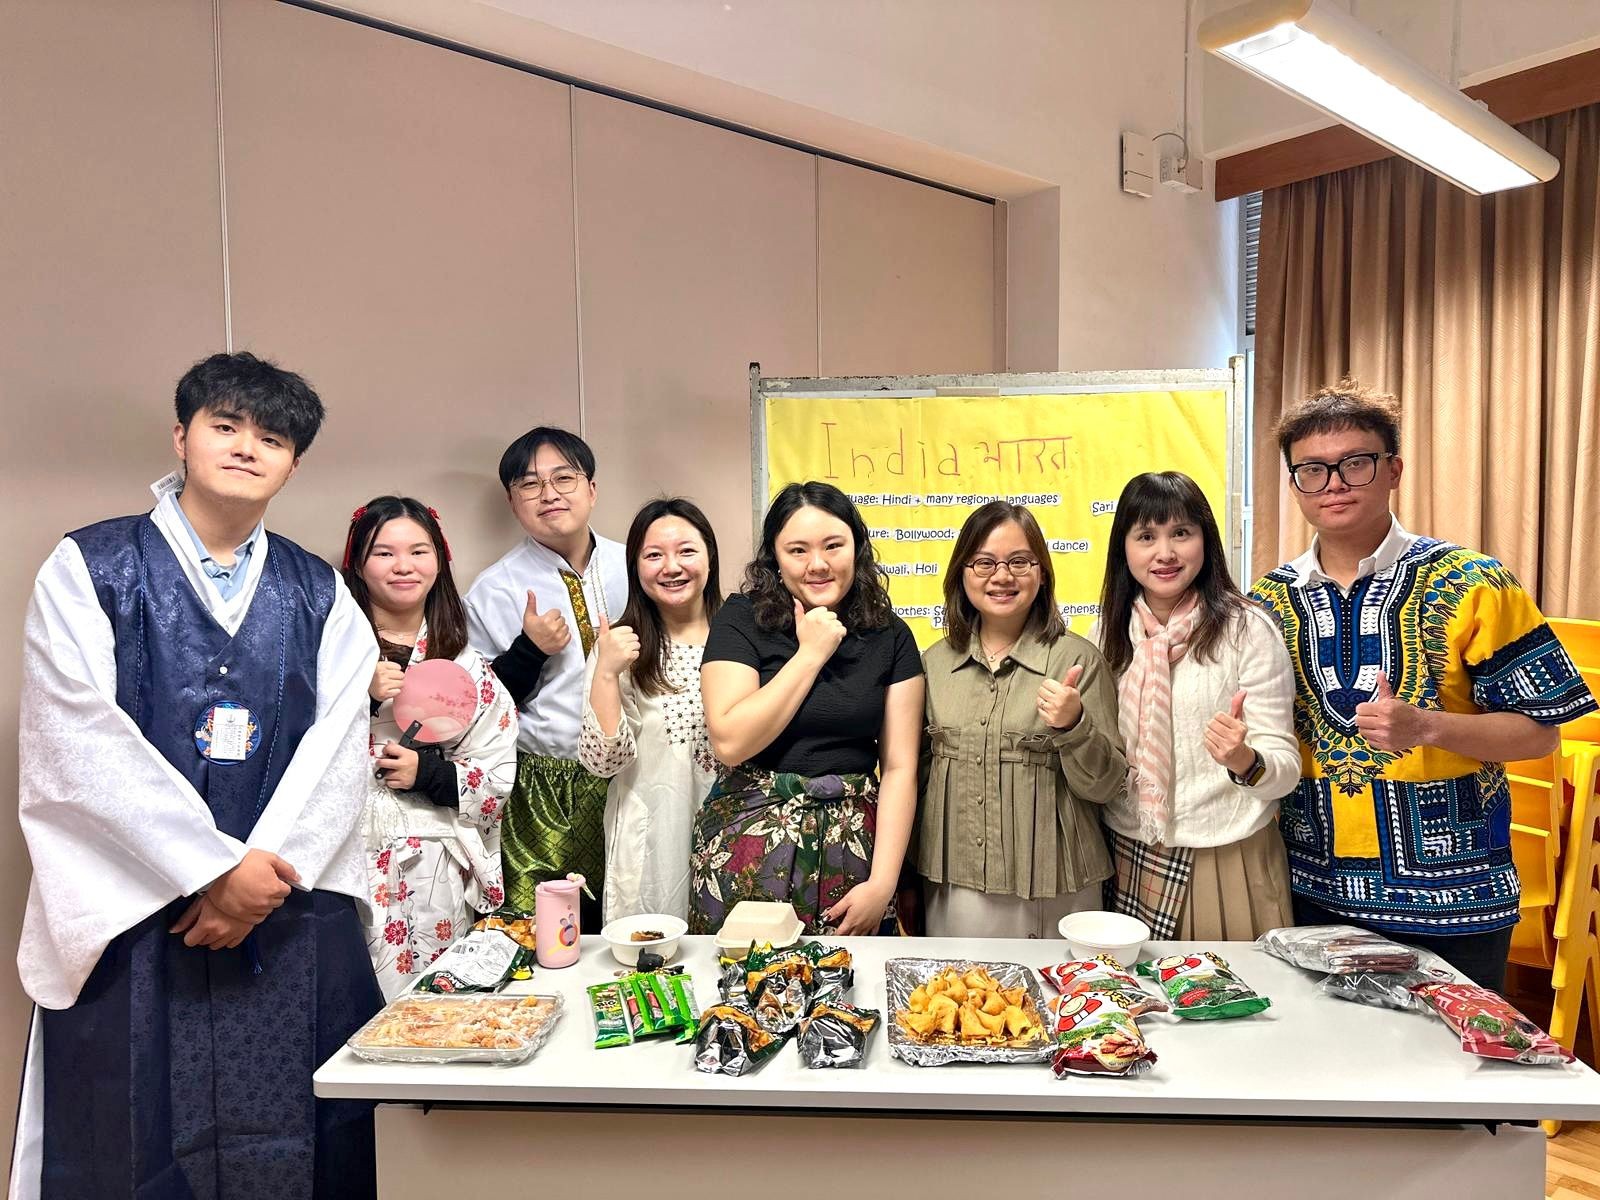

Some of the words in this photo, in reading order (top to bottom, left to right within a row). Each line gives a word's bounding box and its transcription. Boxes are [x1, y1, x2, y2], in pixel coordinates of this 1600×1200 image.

[820, 421, 961, 479] India
[847, 494, 879, 504] uage:
[882, 494, 912, 505] Hindi
[926, 494, 954, 505] many
[1005, 494, 1059, 505] languages
[1092, 501, 1114, 513] Sari
[895, 528, 955, 541] Bollywood;
[1052, 540, 1089, 551] dance)
[915, 563, 938, 574] Holi
